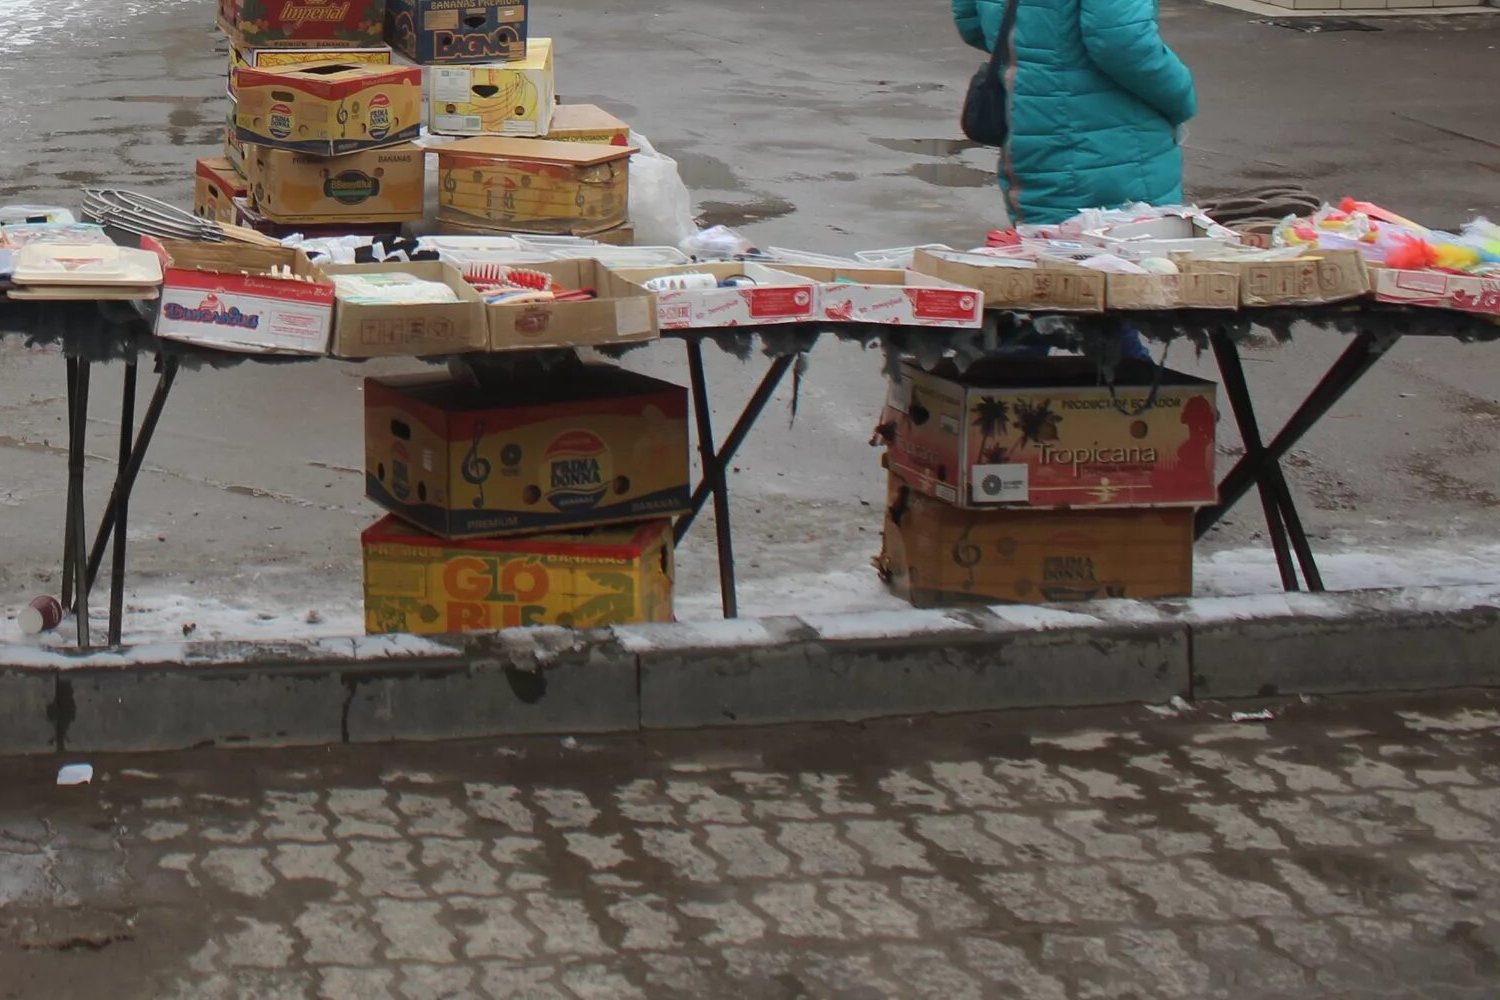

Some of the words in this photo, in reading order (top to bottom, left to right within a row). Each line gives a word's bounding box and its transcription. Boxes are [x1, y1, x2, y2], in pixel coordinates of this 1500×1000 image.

[431, 0, 476, 10] BANANAS
[278, 1, 350, 28] Imperial
[378, 155, 412, 163] BANANAS
[1061, 399, 1109, 409] PRODUCT
[551, 459, 600, 475] PRIMA
[1033, 441, 1157, 478] Tropicana
[551, 472, 601, 488] DONNA
[467, 517, 518, 530] PREMIUM
[443, 555, 549, 602] GLO
